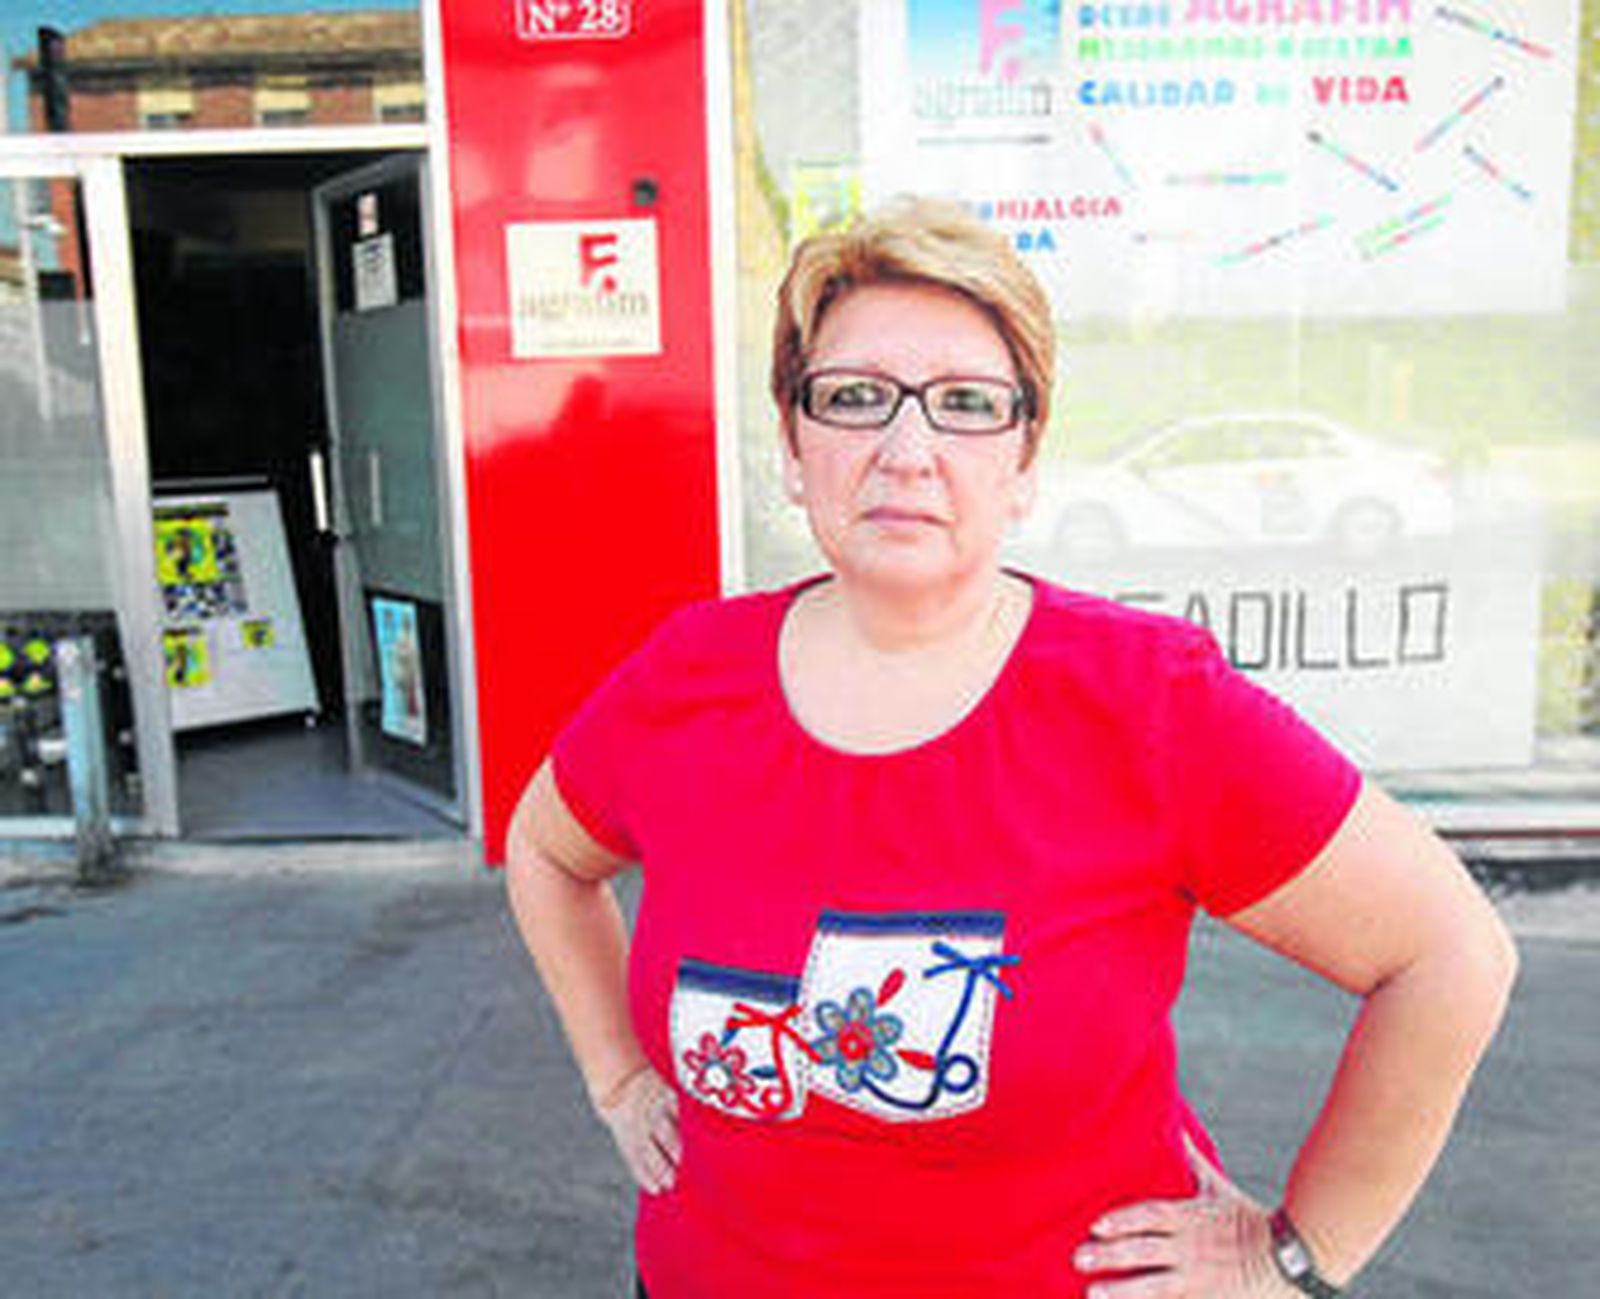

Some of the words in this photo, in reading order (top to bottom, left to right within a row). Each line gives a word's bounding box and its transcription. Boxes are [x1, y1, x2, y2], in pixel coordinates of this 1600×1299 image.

[578, 0, 620, 31] 28
[1076, 79, 1237, 106] CALIDAD
[1311, 74, 1411, 105] VIDA
